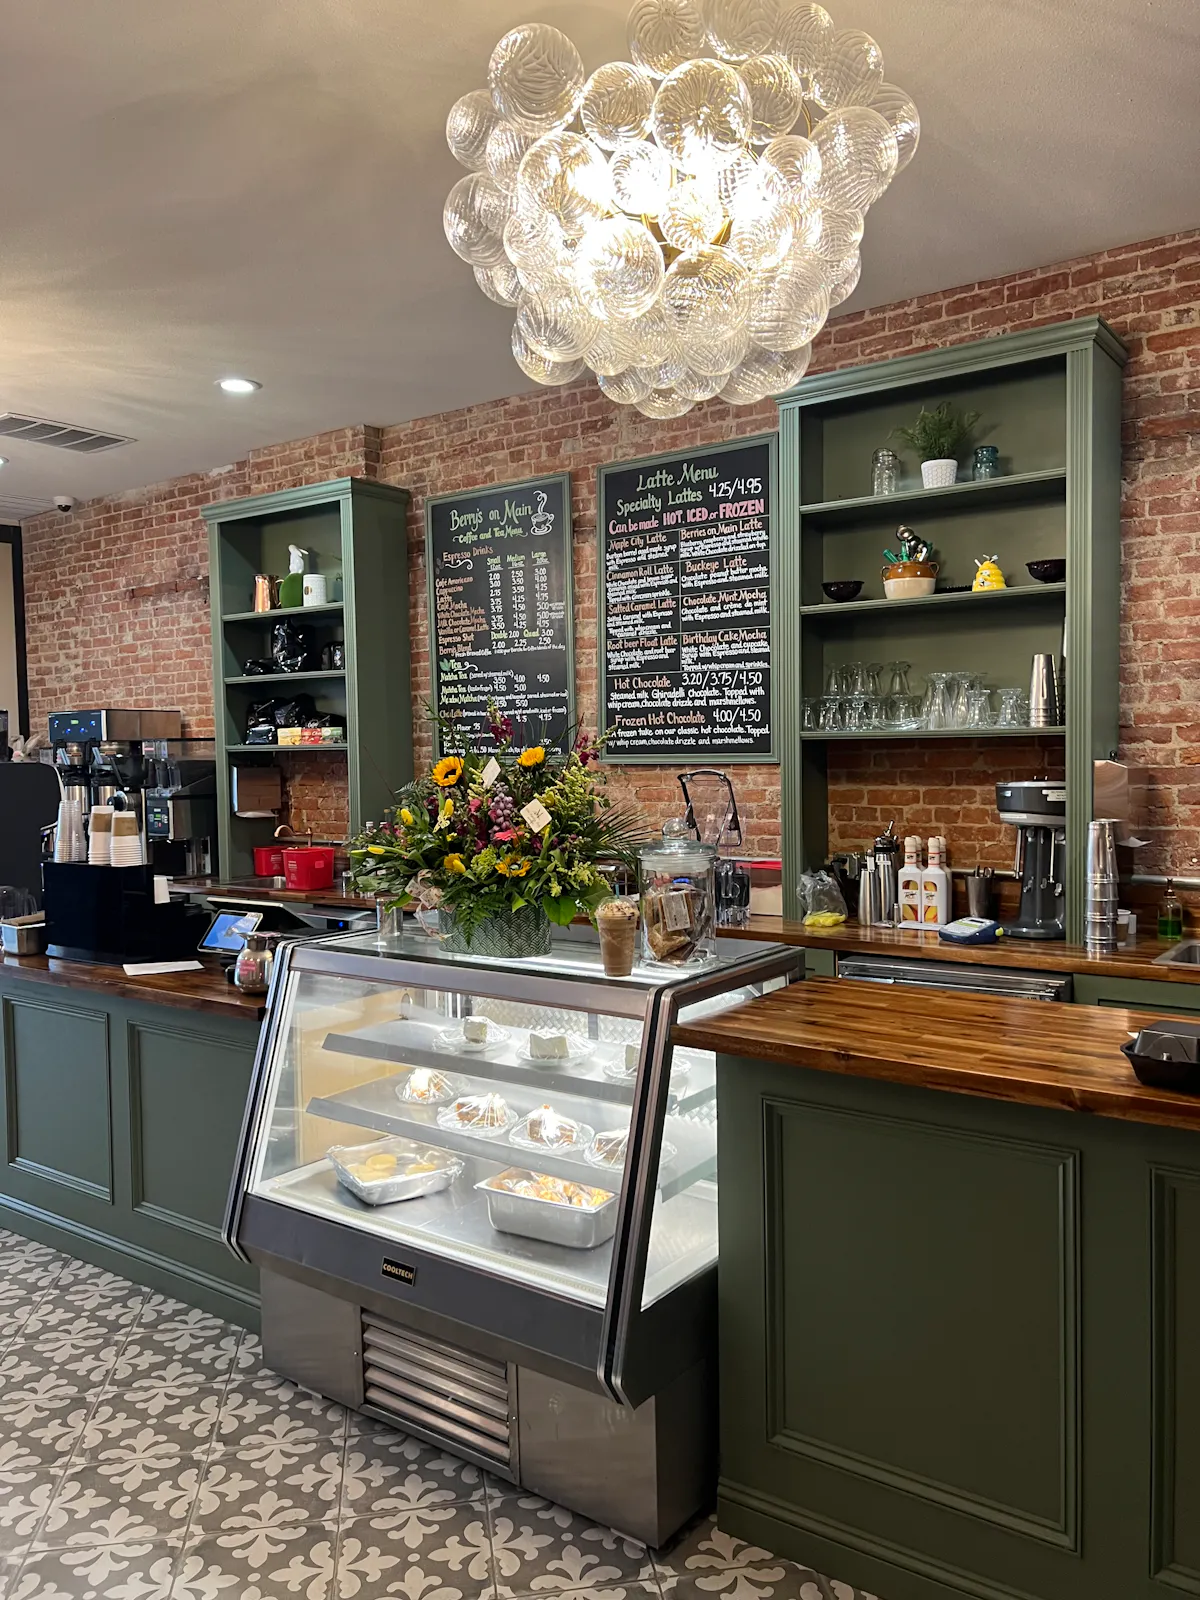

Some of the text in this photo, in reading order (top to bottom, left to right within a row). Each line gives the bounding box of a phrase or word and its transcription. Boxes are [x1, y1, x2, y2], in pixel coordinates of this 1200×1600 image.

[637, 463, 719, 492] Latte Menu
[616, 477, 762, 517] Specialty Lattes 4.25/4.95
[450, 499, 533, 532] Berry's on Main
[609, 519, 627, 534] Can
[628, 522, 638, 532] be
[639, 517, 659, 530] made
[710, 511, 718, 520] or
[719, 498, 764, 519] FROZEN
[458, 525, 523, 544] Coffee and Tea Menu
[680, 517, 763, 540] Berries on Main Latte
[608, 532, 668, 551] Maple City Latte
[443, 545, 493, 565] Espresso Drinks
[487, 551, 547, 566] Small Medium Large
[685, 555, 747, 573] Buckeye Latte
[489, 573, 500, 581] 2.00
[511, 570, 523, 578] 2.50
[535, 567, 546, 576] 3.00
[607, 564, 674, 581] Cinnamon Roll Latte
[682, 573, 708, 582] Chocolate
[730, 567, 748, 575] butter
[490, 575, 547, 588] 3.00 3.50 4.00
[490, 589, 501, 598] 2.75
[512, 585, 524, 594] 3.50
[490, 598, 501, 606] 3.75
[536, 591, 548, 601] 4.75
[683, 588, 767, 606] Chocolate Mint Mocha
[491, 605, 502, 613] 3.75
[513, 602, 525, 611] 4.50
[537, 602, 549, 611] 5.00
[609, 598, 676, 615] Salted Caramel Latte
[682, 605, 709, 615] Chocolate
[491, 615, 503, 623] 3.75
[513, 612, 526, 620] 4.50
[537, 611, 549, 620] 5.00
[695, 612, 720, 622] Espresso
[491, 622, 504, 630] 3.50
[439, 628, 553, 646] Espresso Shot Double 2.00 Quad 3.00
[492, 641, 505, 649] 2.00
[514, 638, 526, 647] 2.25
[539, 636, 551, 644] 2.50
[607, 636, 678, 650] Root beer Float Latte
[683, 629, 767, 646] Birthday Cake Mocha
[450, 659, 462, 669] Tea
[514, 674, 525, 682] 4.00
[537, 673, 549, 682] 4.50
[614, 670, 763, 690] Hot Chocolate 3.20/3.75/4.50
[494, 683, 506, 691] 4.50
[514, 684, 526, 692] 5.00
[610, 690, 636, 700] Steamed
[722, 685, 748, 698] Topped
[749, 686, 765, 696] with
[607, 700, 621, 711] whip
[672, 697, 693, 707] drizzle
[693, 697, 707, 707] and
[615, 706, 762, 726] Frozen Hot Chocolate 4.00/4.50
[617, 728, 637, 738] frozen
[638, 727, 654, 736] take
[677, 726, 699, 735] classic
[700, 725, 712, 734] hot
[746, 724, 770, 737] Topped
[616, 739, 630, 748] whip
[647, 737, 675, 745] chocolate
[675, 736, 697, 745] drizzle
[698, 736, 710, 745] and
[383, 1263, 414, 1279] COOLTECH
